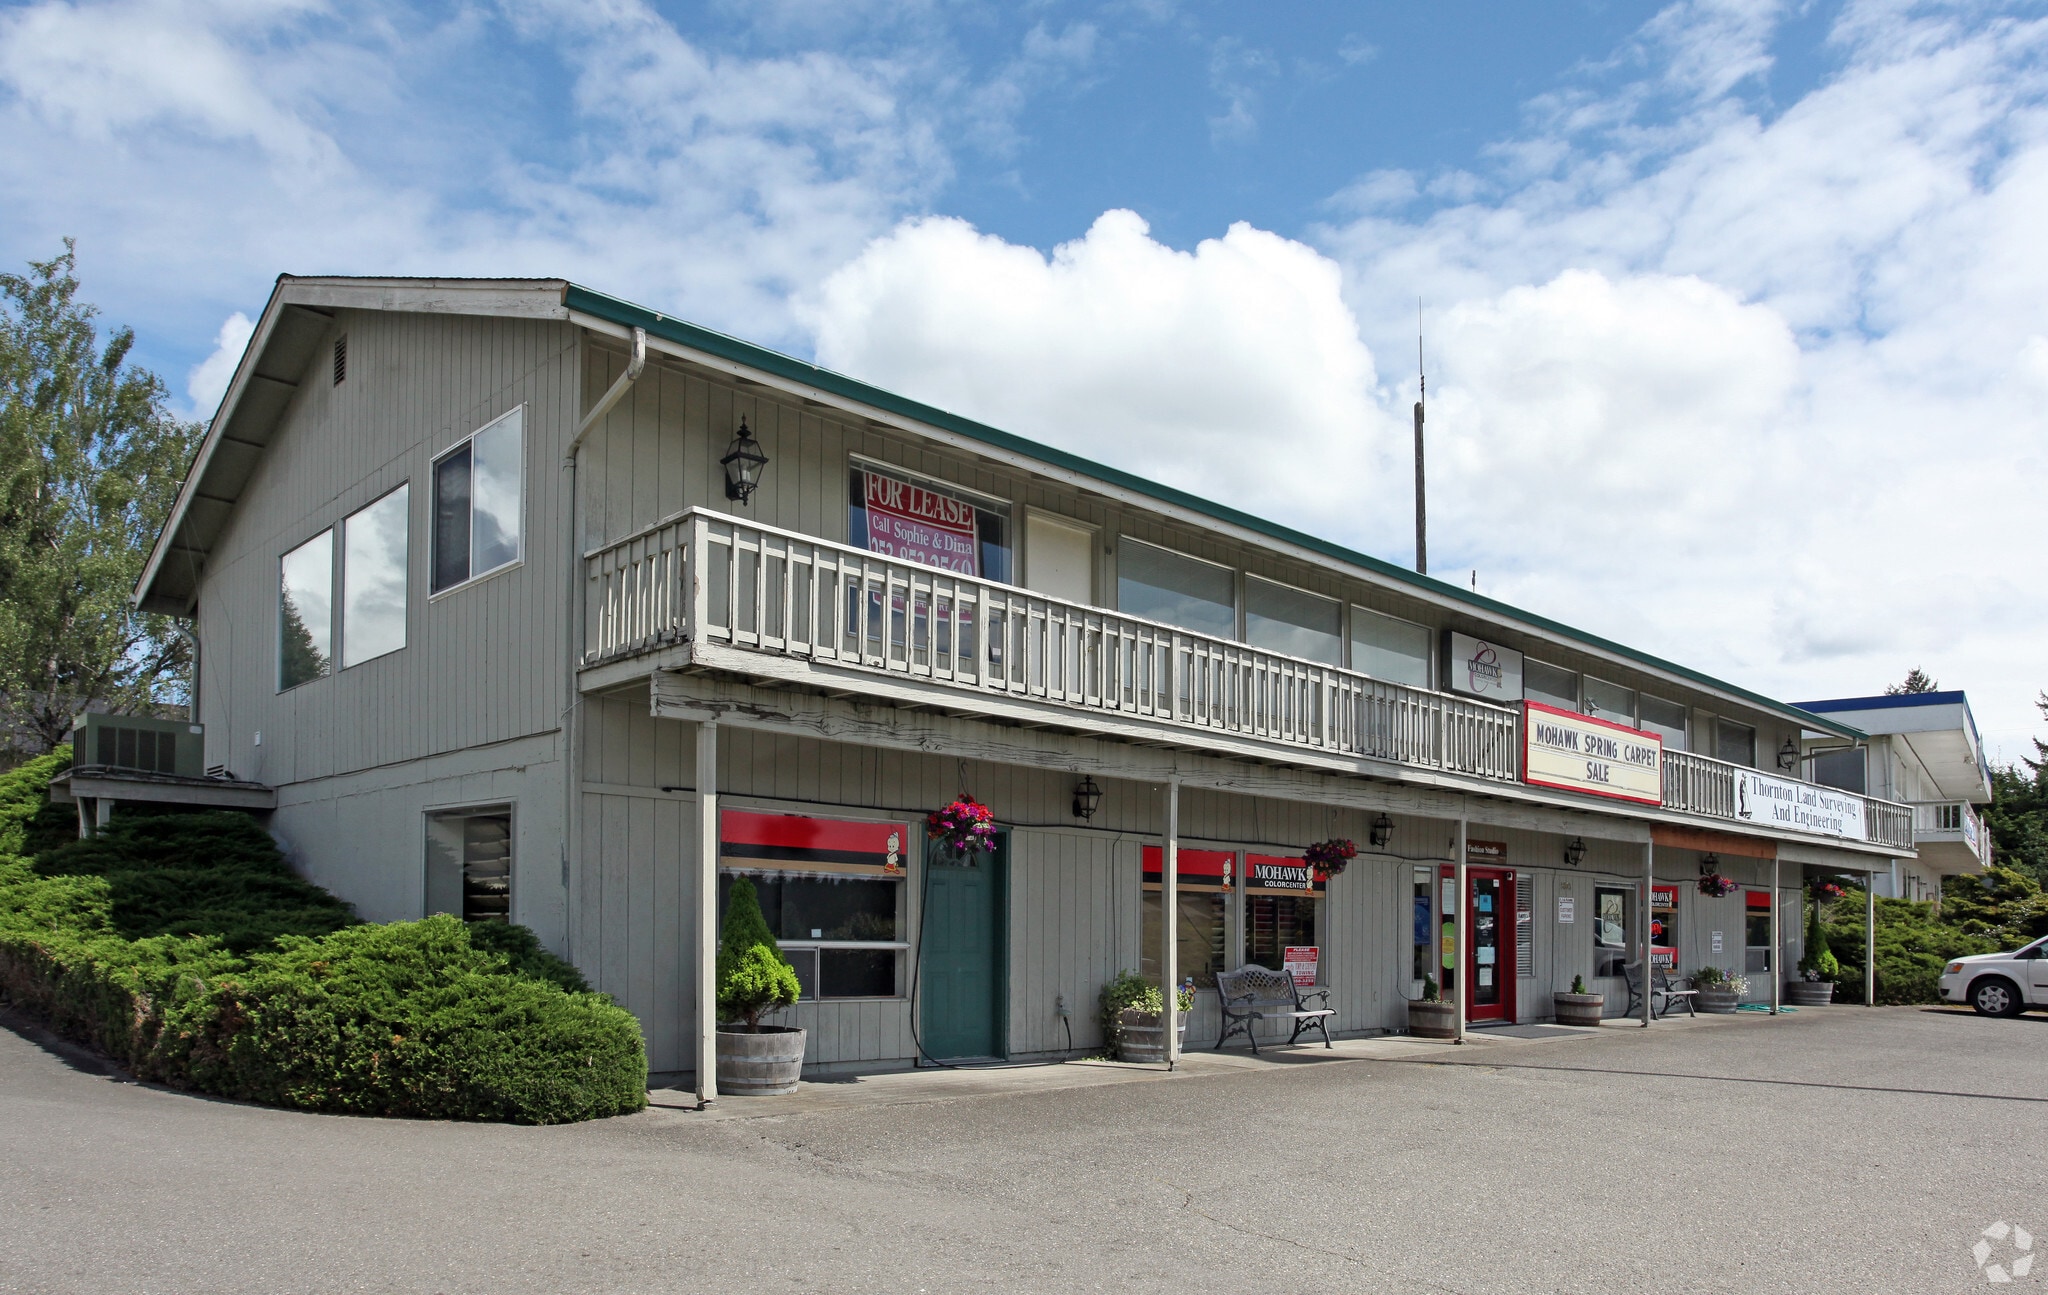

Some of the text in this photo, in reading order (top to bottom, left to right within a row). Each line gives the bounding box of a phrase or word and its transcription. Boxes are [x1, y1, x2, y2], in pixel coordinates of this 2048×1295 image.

[868, 473, 971, 526] FOR LEASE
[873, 515, 973, 555] Call Sophie & Dina
[1536, 724, 1657, 768] MOHAWK SPRING CARPET
[1586, 761, 1609, 783] SALE
[1751, 776, 1857, 820] Thornton Land Surveying
[1772, 803, 1843, 835] And Engineering
[1254, 864, 1307, 882] MOHAWK
[1264, 880, 1306, 889] COLORCENTER
